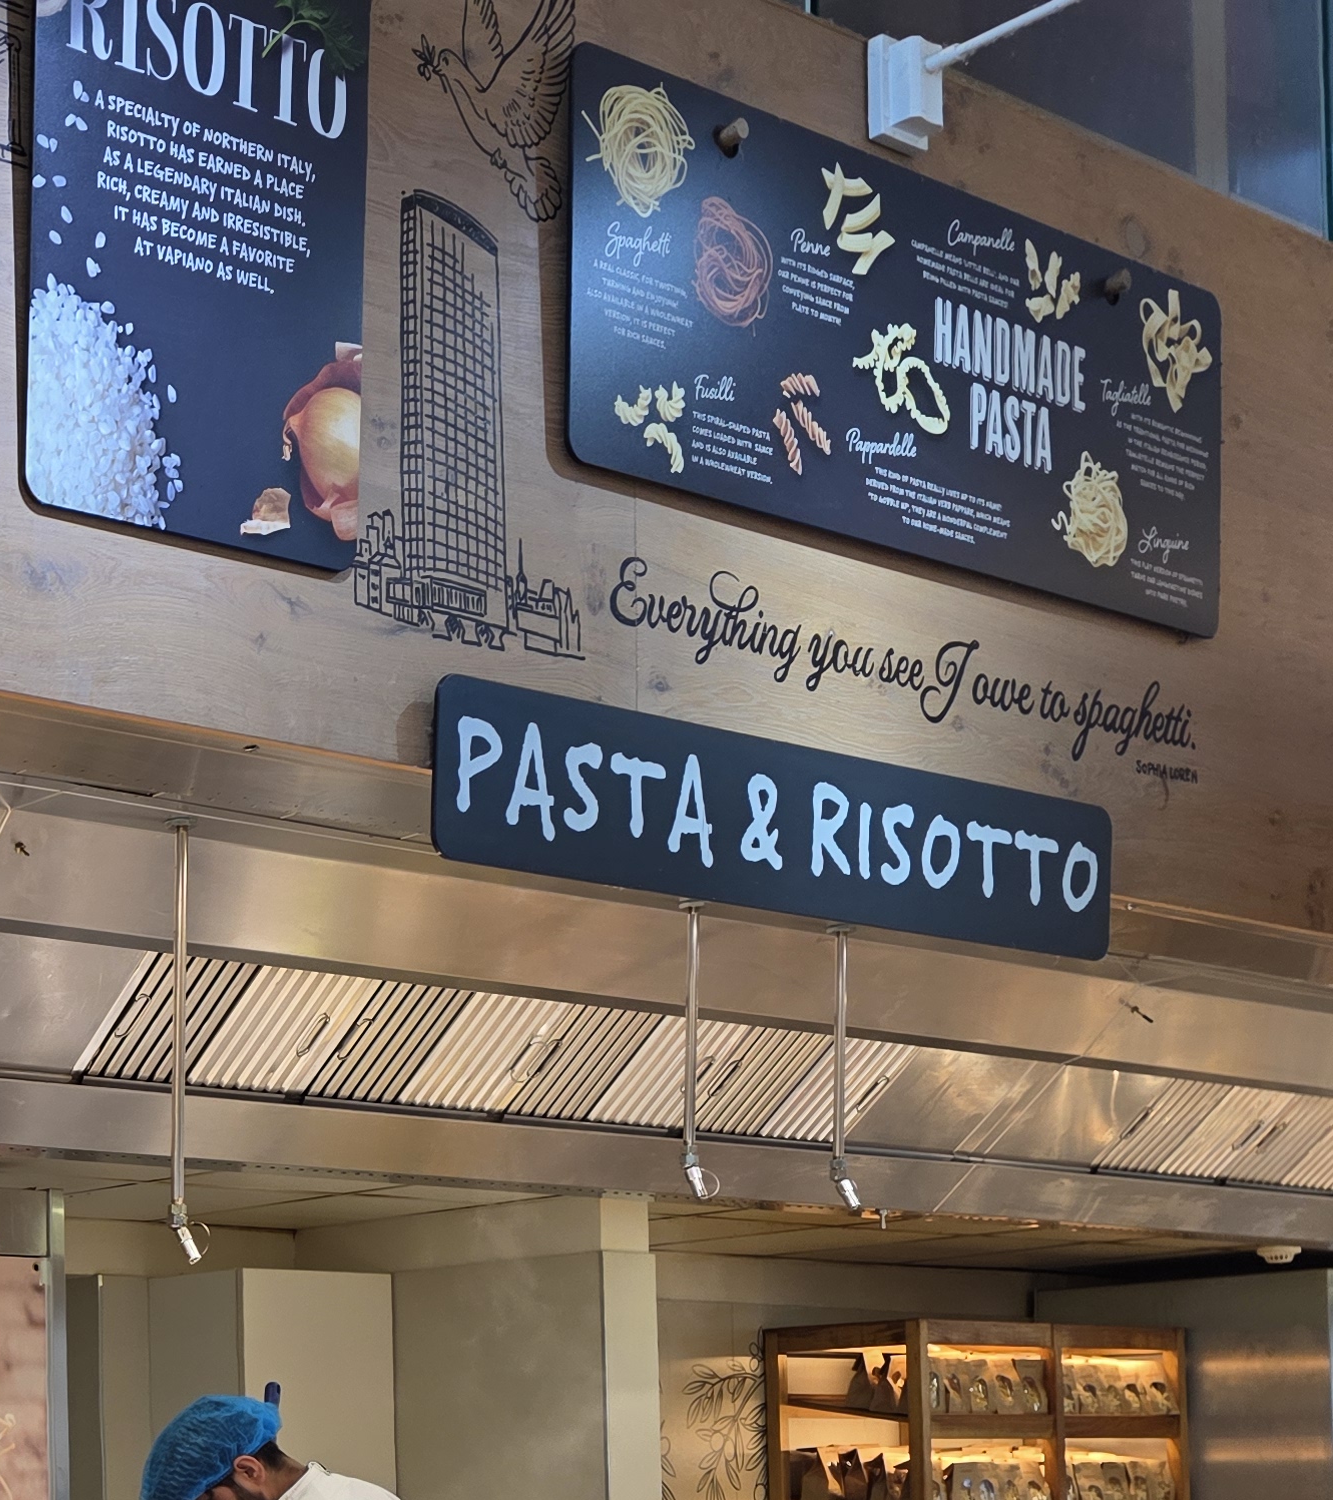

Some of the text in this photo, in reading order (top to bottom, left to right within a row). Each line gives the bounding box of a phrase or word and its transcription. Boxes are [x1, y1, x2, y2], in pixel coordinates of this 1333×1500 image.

[94, 89, 315, 182] A SPECIALTY OF NORTHERN ITALY,
[107, 120, 304, 198] RISOTTO HAS EARNED A PLACE
[97, 171, 310, 257] RICH, CREAMY AND IRRESISTIBLE,
[103, 146, 305, 226] AS A LEGENDARY ITALIAN DISH.
[114, 205, 295, 272] IT HAS BECOME A FAVORITE
[134, 236, 274, 294] AT VAPIANO AS WELL.
[604, 221, 672, 267] Spaghetti
[790, 228, 830, 257] Penne
[948, 219, 1015, 256] Campanelle
[933, 295, 1087, 414] HANDMADE
[694, 374, 736, 401] Fusilli
[1100, 378, 1152, 416] Tagliatelle
[846, 428, 917, 464] Pappardelle
[969, 381, 1053, 473] PASTA
[1138, 526, 1189, 563] Linguine
[609, 557, 1196, 761] Everything you see I owe to spaghetti.
[1136, 760, 1198, 784] SOPHIA LOREN
[455, 714, 1100, 913] PASTA & RISOTTO
